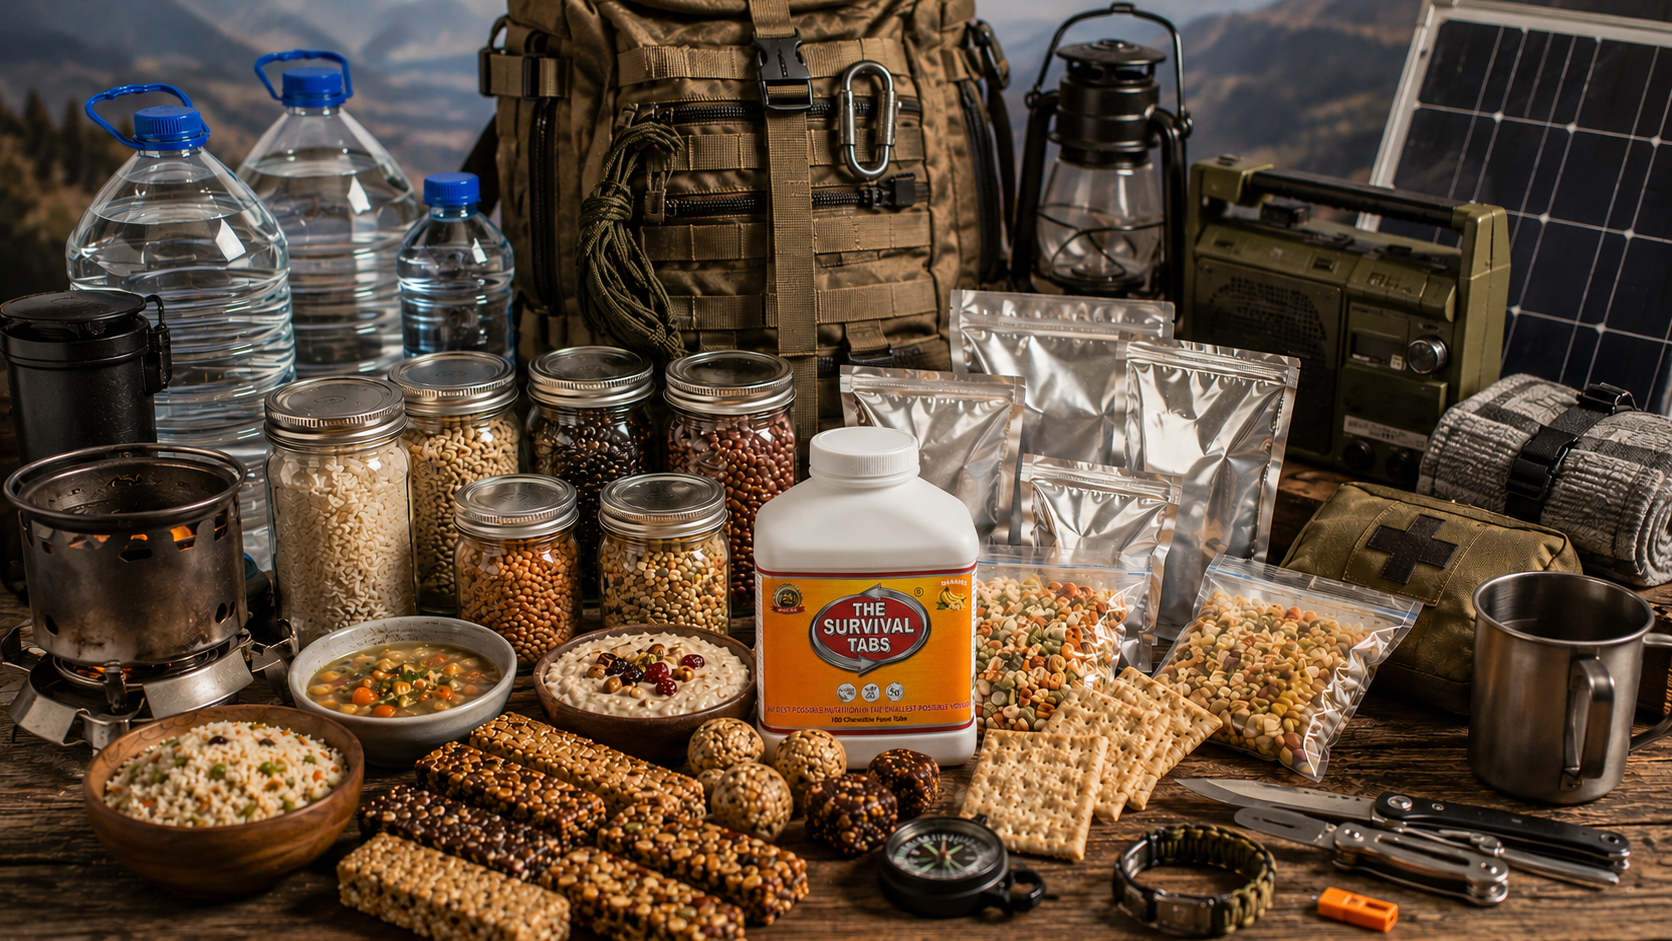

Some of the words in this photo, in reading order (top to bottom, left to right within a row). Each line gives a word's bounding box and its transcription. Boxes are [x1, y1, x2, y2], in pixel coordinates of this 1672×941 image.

[852, 602, 886, 616] THE
[824, 617, 916, 636] SURVIVAL
[847, 637, 891, 653] TABS
